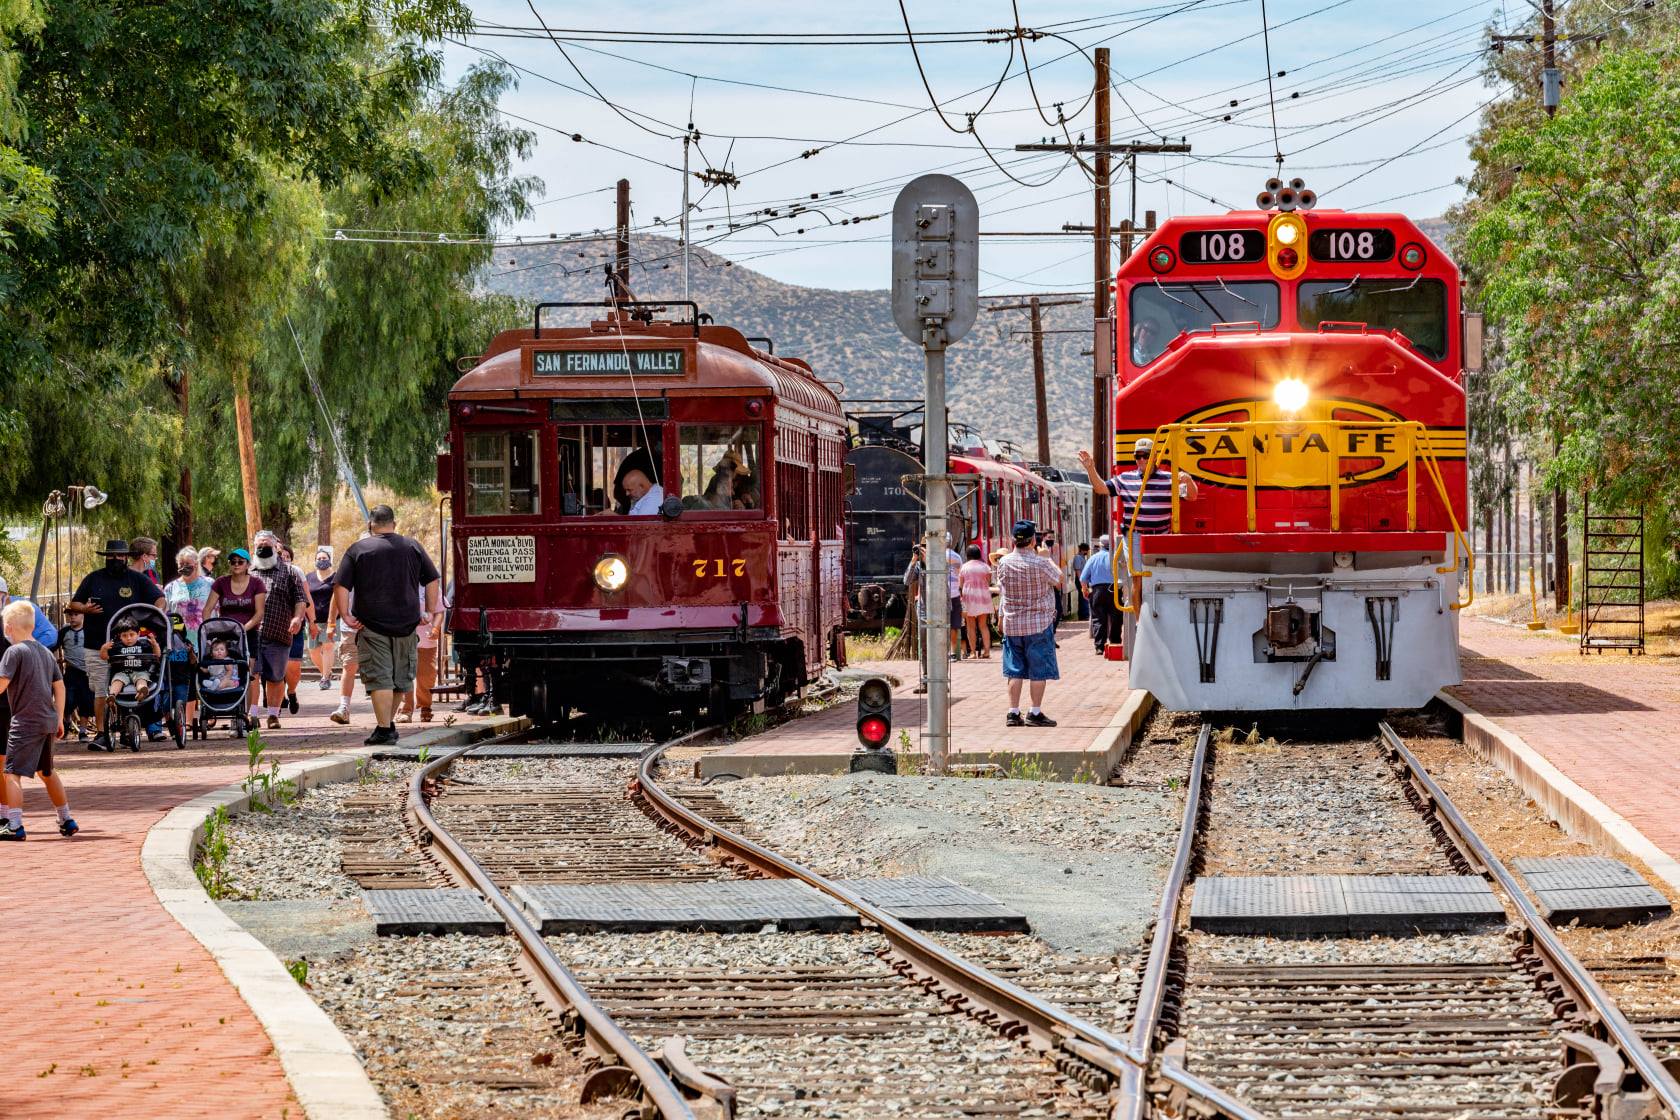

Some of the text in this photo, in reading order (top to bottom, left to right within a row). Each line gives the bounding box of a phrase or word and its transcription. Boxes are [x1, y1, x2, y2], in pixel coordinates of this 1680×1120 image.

[1200, 233, 1245, 260] 108
[1330, 232, 1374, 259] 108
[537, 352, 680, 372] SAN FERNANDO VALLEY
[1348, 433, 1396, 453] FE
[468, 548, 535, 556] CAHUENGA PASS
[469, 539, 490, 548] SANTA
[491, 539, 516, 548] MONICA
[469, 564, 534, 572] NORTH HOLLYWOOD
[470, 556, 534, 564] UNIVERSAL CITY
[692, 558, 746, 577] 717
